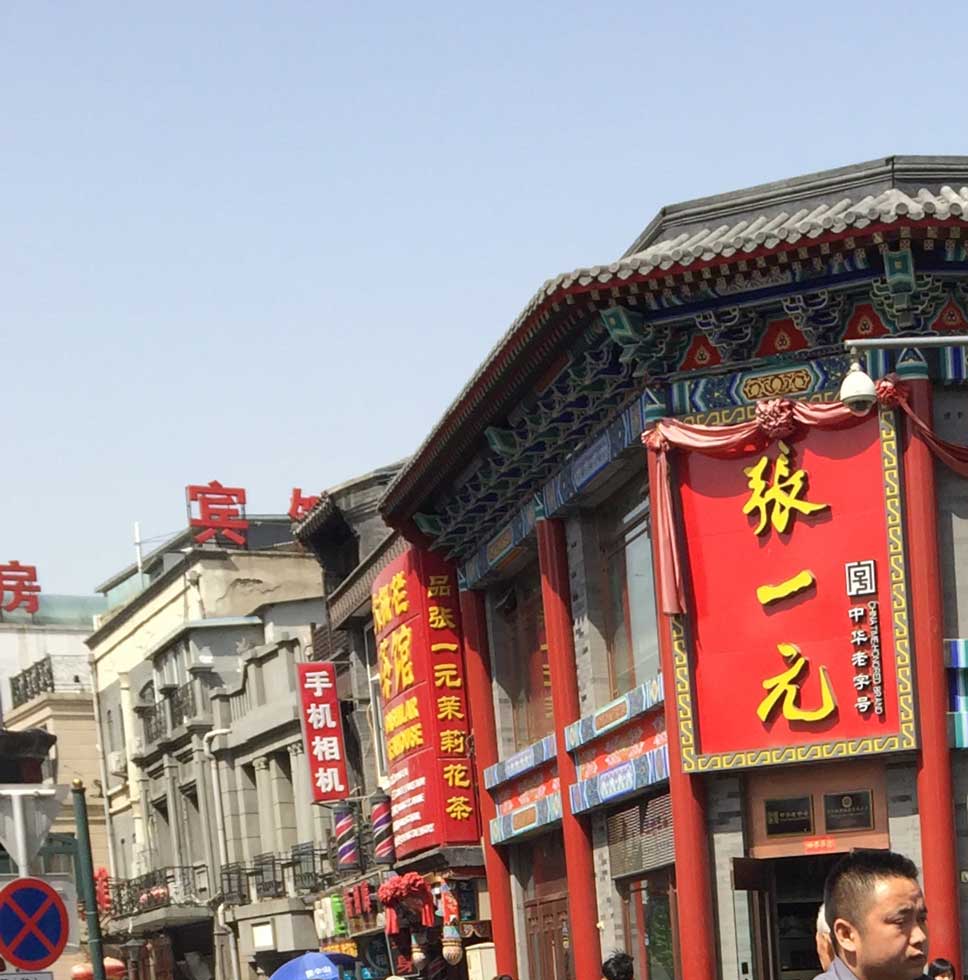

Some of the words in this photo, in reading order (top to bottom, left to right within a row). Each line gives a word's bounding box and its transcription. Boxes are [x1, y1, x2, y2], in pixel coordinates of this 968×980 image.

[0, 560, 41, 614] 房
[743, 441, 832, 722] 张一元
[427, 575, 473, 821] 品张一元茉莉花茶
[848, 607, 871, 713] 中华老字号
[873, 686, 884, 715] BRAND
[304, 671, 345, 793] 手机相机
